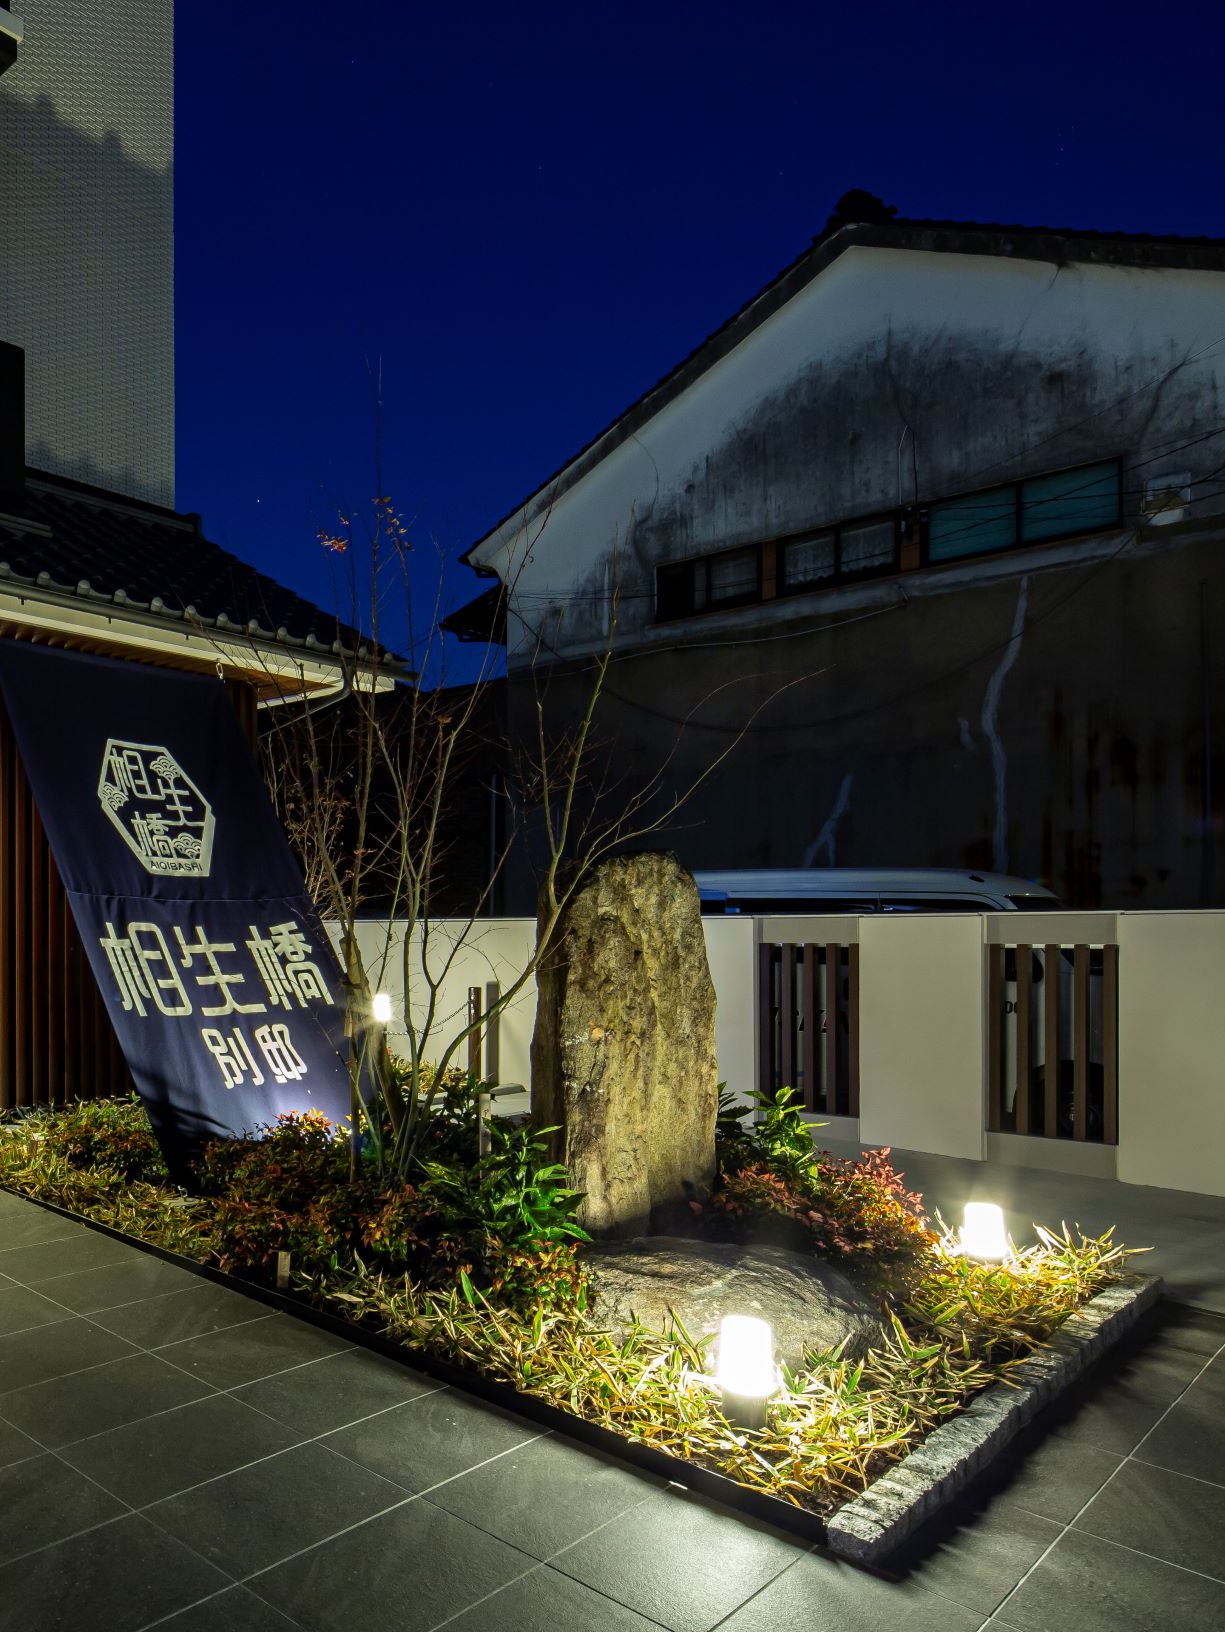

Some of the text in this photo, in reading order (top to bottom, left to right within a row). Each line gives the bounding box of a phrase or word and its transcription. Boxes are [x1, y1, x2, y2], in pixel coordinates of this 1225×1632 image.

[150, 860, 203, 872] AIOIBASHI
[99, 922, 334, 1016] 相生橋
[201, 1023, 308, 1089] 別邸
